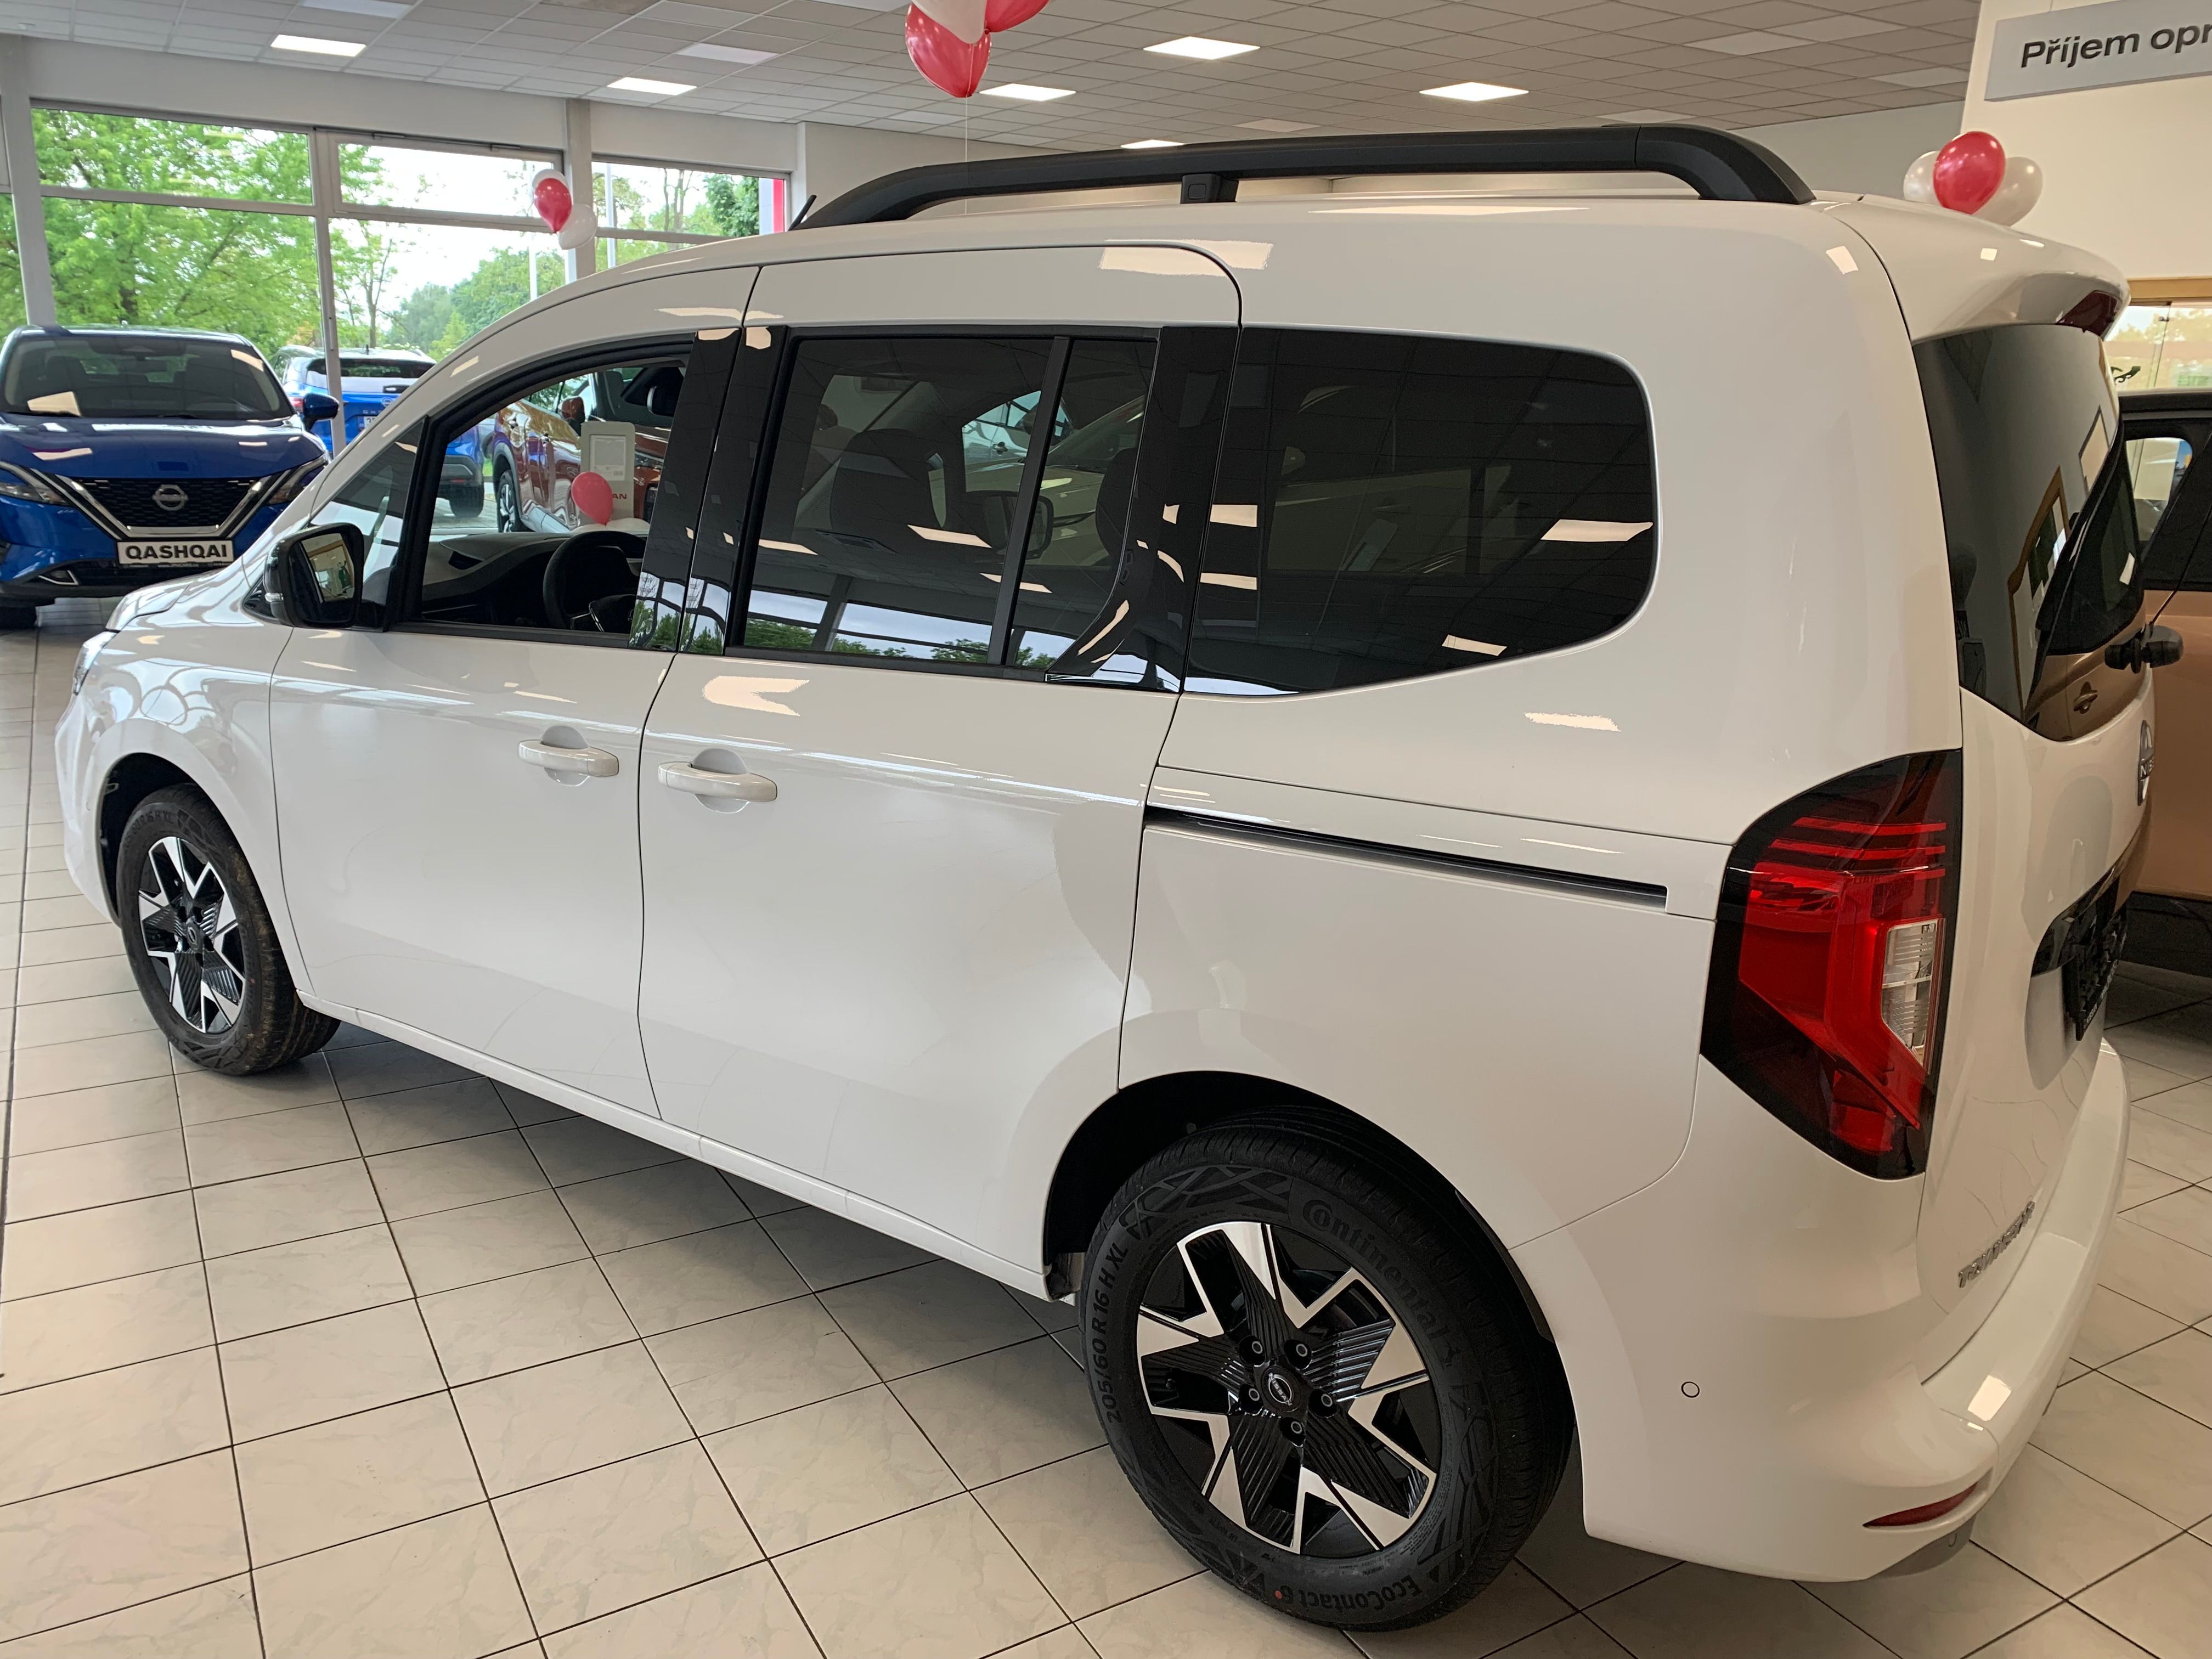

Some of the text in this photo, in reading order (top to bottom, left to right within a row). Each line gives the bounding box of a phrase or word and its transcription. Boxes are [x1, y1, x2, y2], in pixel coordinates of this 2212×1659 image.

[2022, 33, 2140, 68] Příjem
[125, 544, 227, 560] QASHQAI
[1302, 1199, 1449, 1340] Continental
[1091, 1242, 1128, 1424] 205/60 R 16 H XL
[1299, 1575, 1423, 1612] EcoContact
